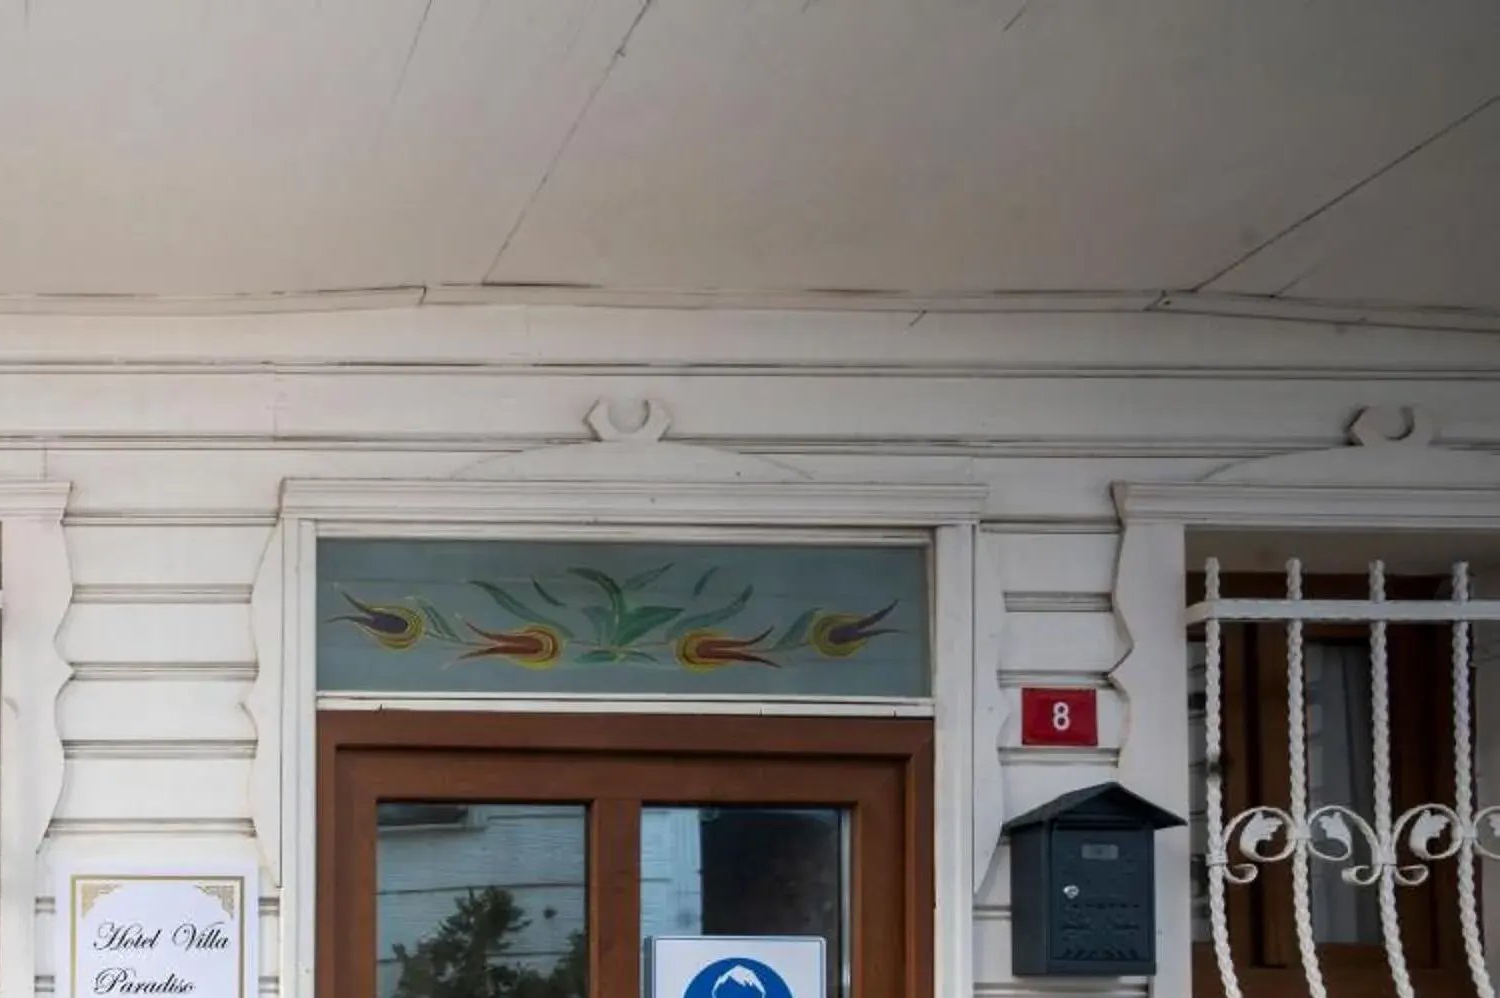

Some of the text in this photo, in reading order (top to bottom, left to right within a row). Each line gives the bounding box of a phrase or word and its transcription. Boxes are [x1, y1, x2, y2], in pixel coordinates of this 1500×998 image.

[1053, 702, 1070, 730] 8
[93, 921, 231, 952] Hotel Villa
[93, 966, 196, 995] Paradiso
